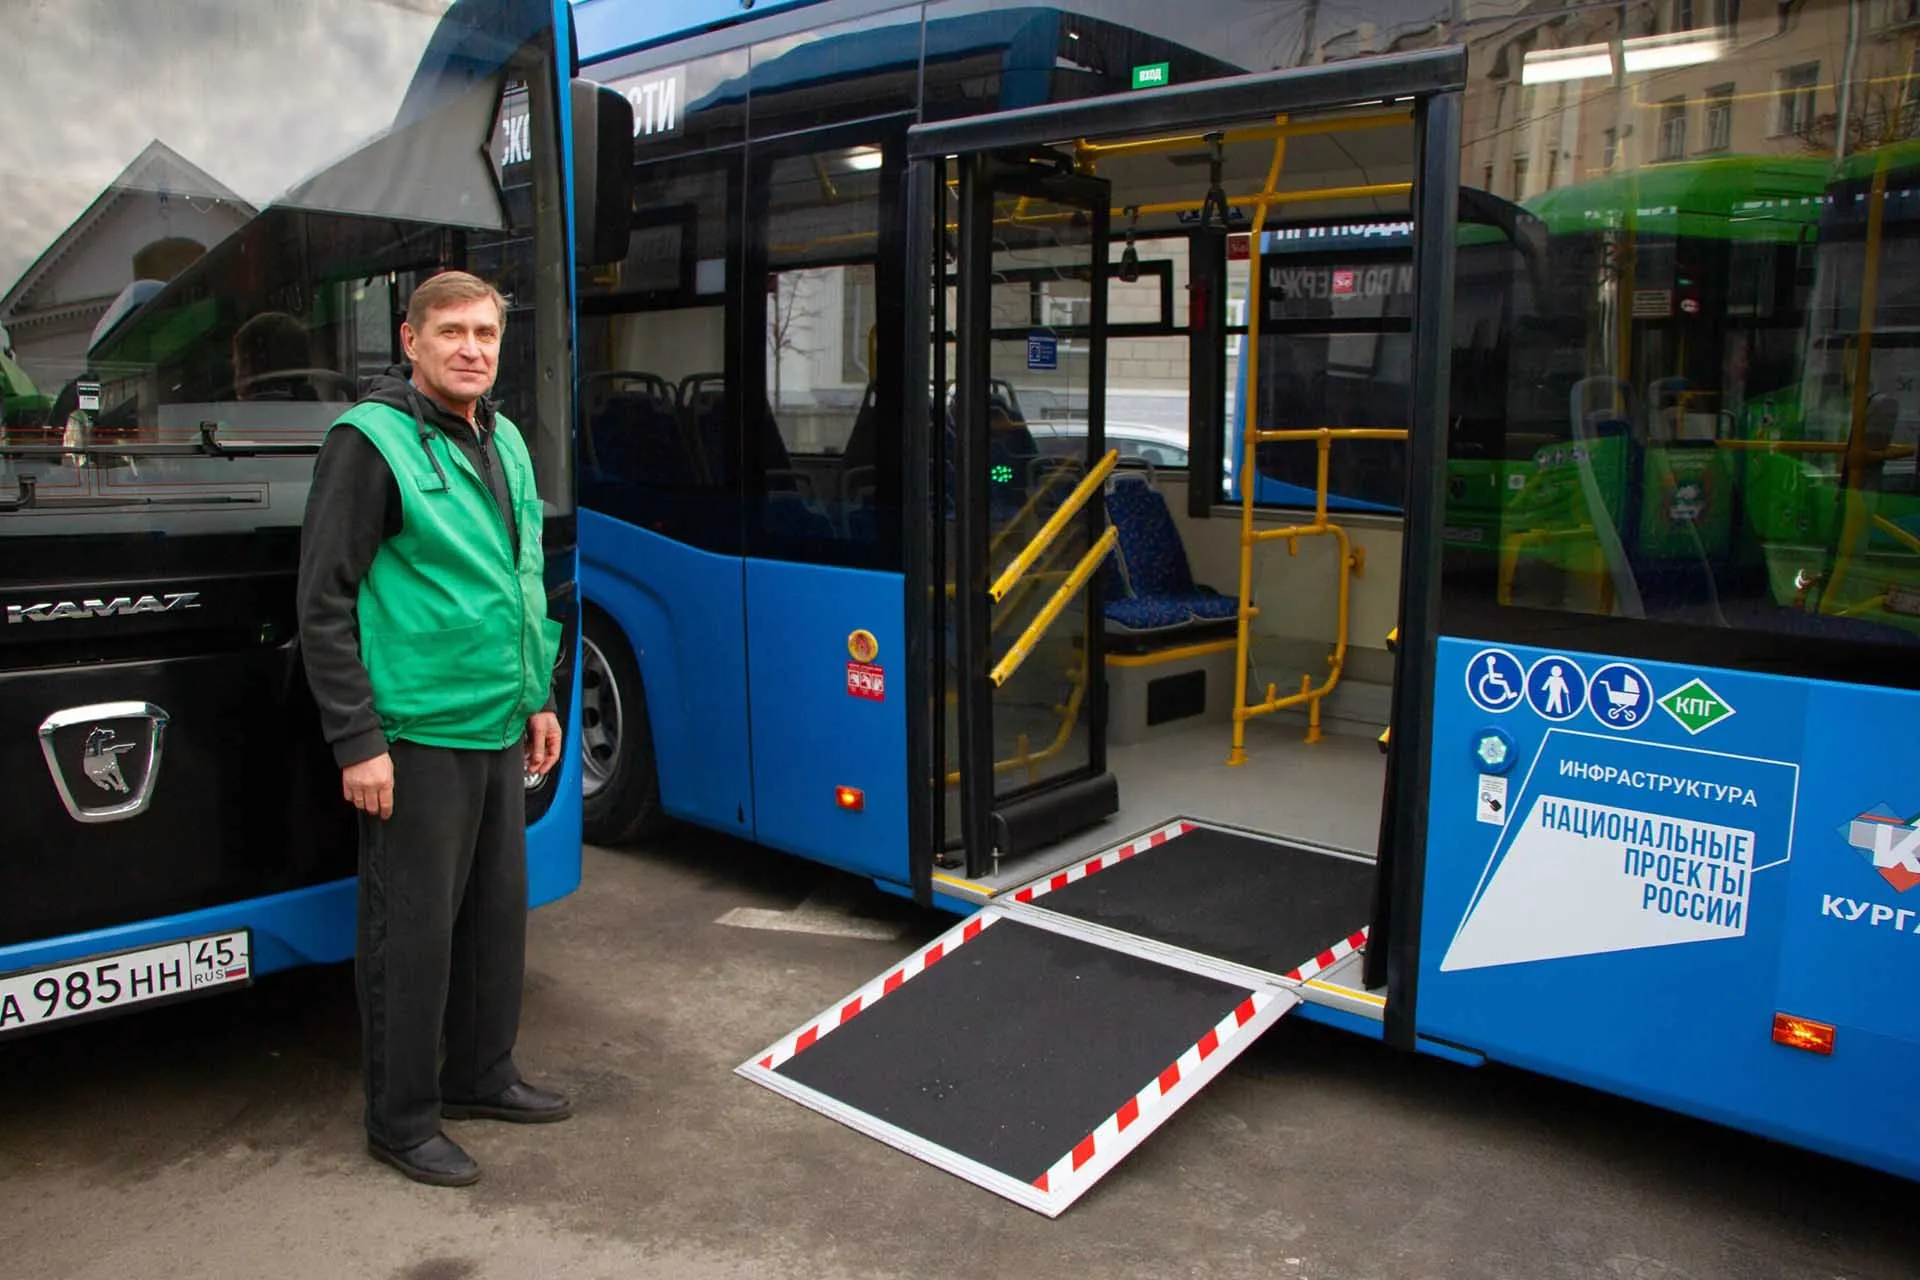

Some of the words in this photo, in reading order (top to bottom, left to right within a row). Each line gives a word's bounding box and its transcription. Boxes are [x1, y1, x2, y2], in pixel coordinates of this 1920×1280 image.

[627, 77, 676, 138] СТИ
[6, 592, 201, 624] KAMAZ
[1676, 696, 1717, 717] КПГ
[1559, 759, 1758, 808] ИНФРАСТРУКТУРА
[1541, 801, 1749, 865] НАЦИОНАЛЬНЫЕ
[1624, 847, 1745, 897] ПРОЕКТЫ
[1642, 883, 1743, 929] РОССИИ
[194, 968, 225, 985] RUS
[195, 937, 234, 970] 45
